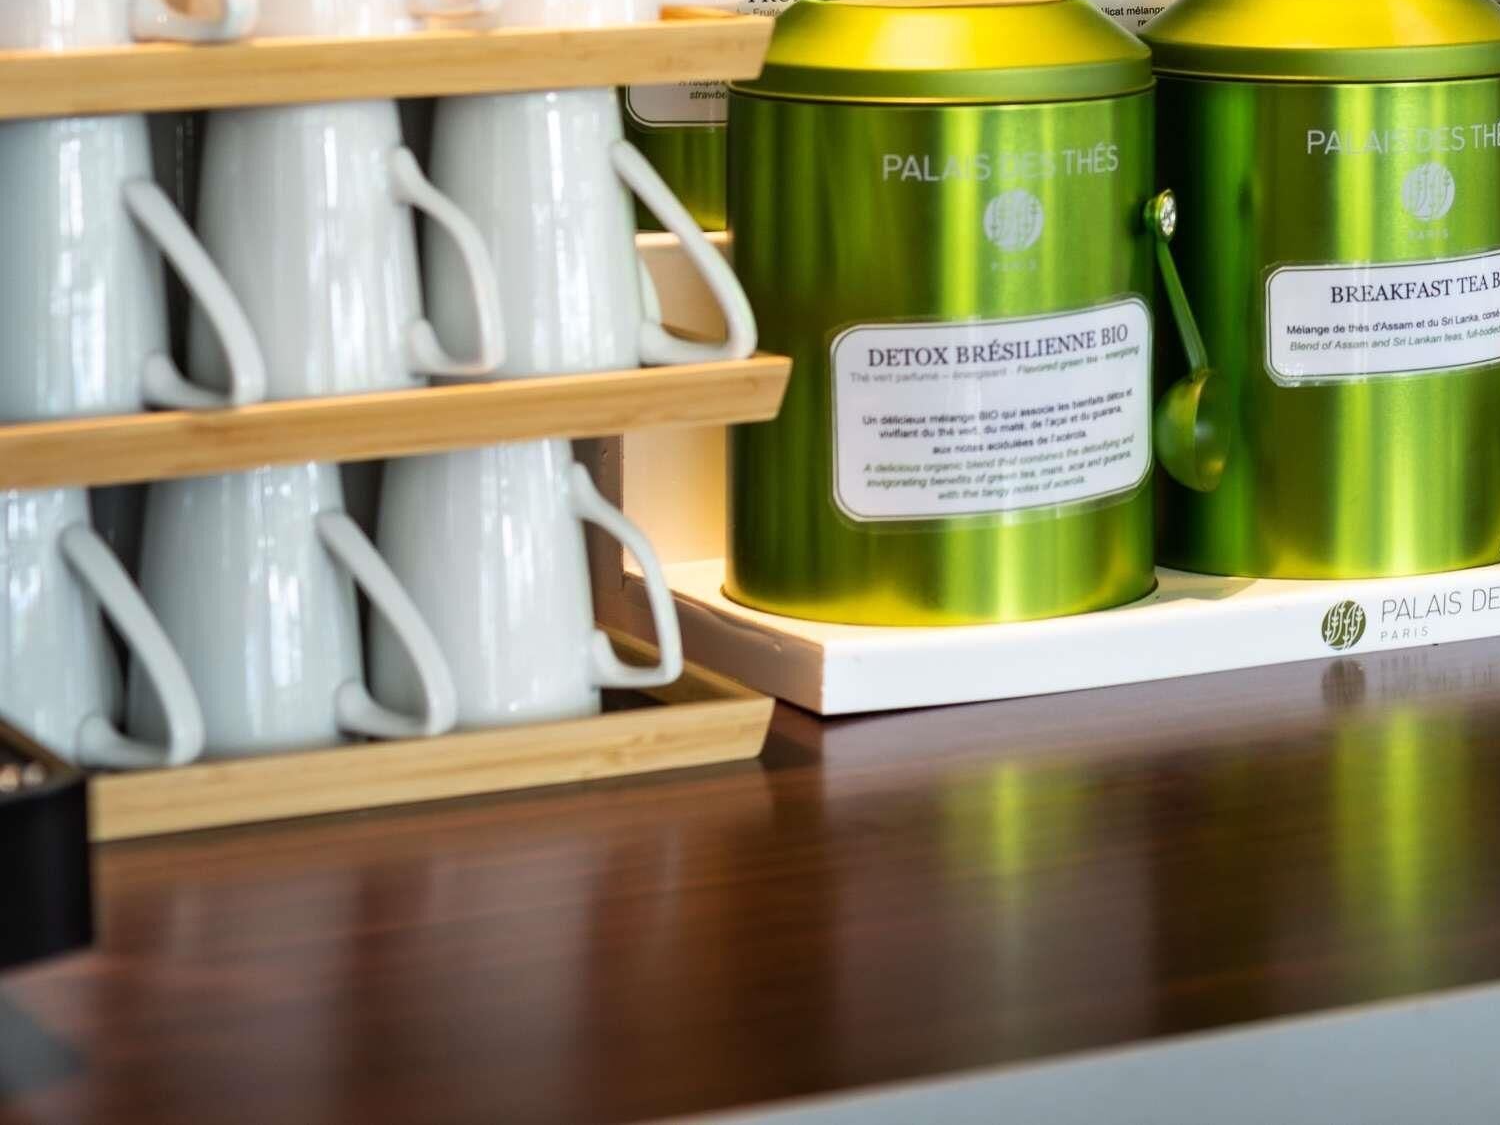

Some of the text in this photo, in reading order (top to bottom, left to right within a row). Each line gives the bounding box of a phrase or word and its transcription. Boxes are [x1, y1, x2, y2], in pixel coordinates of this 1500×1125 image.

[1100, 6, 1124, 16] licat
[1307, 127, 1409, 155] PALAIS
[1416, 126, 1465, 153] DES
[882, 142, 1120, 182] PALAIS DES THÉS
[1330, 279, 1453, 304] BREAKFAST
[1456, 274, 1488, 294] TEA
[1287, 324, 1331, 337] Mélange
[1332, 323, 1345, 334] de
[1348, 322, 1370, 334] thés
[1373, 319, 1414, 332] d'Assam
[1416, 319, 1426, 329] et
[1428, 317, 1439, 328] du
[1441, 315, 1454, 326] Sri
[868, 324, 1128, 367] DETOX BRÉSILIENNE BIO
[1290, 341, 1320, 352] Blend
[1321, 339, 1332, 350] of
[1334, 339, 1369, 350] Assam
[1371, 337, 1391, 349] and
[1393, 336, 1407, 347] Sri
[1408, 333, 1442, 346] Lankan
[1382, 590, 1462, 623] PALAIS
[1380, 625, 1429, 643] PARIS
